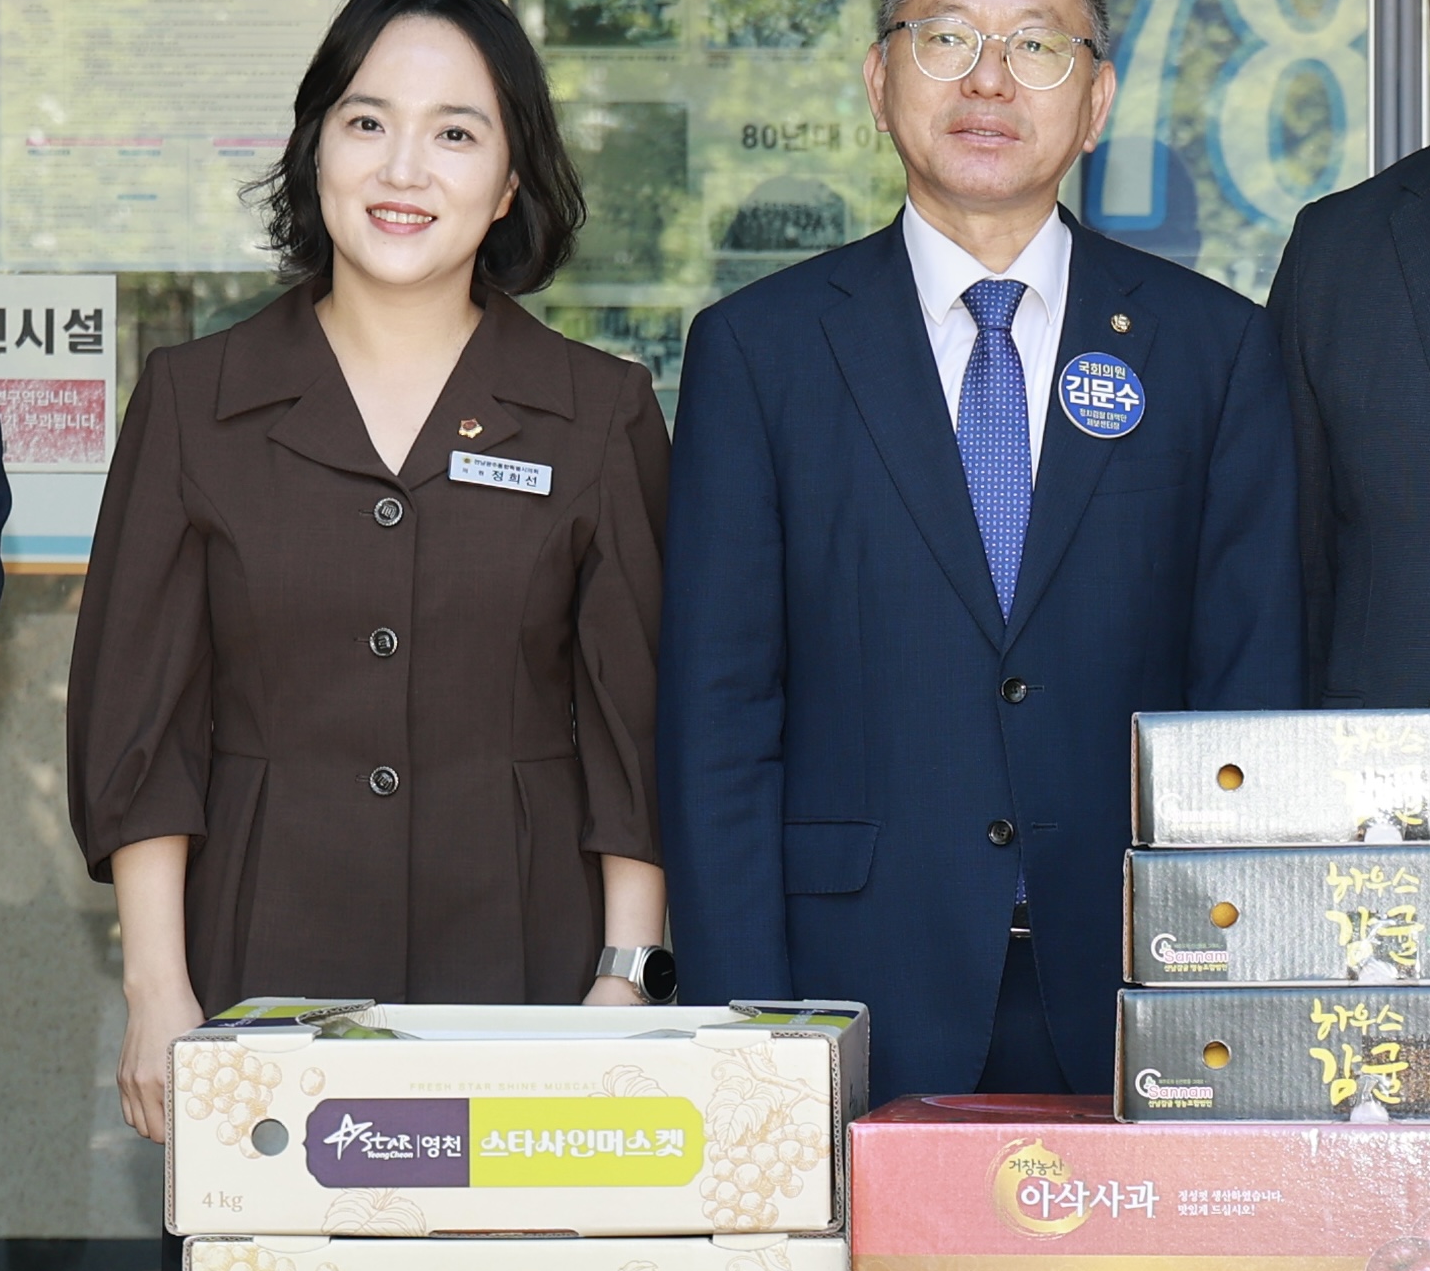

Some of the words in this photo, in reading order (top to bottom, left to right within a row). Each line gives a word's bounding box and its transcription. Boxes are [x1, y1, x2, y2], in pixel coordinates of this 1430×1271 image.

[1078, 361, 1126, 380] 국회의원
[1066, 376, 1140, 412] 김문수
[492, 469, 538, 488] 정희선
[1326, 861, 1420, 904] 하우스
[1324, 904, 1425, 968] 감귤
[1164, 949, 1229, 964] Sannam
[1310, 998, 1405, 1041] 하우스
[410, 1082, 453, 1091] FRESH
[458, 1082, 492, 1091] STAR
[498, 1081, 540, 1091] SHINE
[545, 1081, 599, 1091] MUSCAT
[1309, 1043, 1409, 1106] 감귤
[1147, 1085, 1214, 1100] Sannam
[421, 1135, 462, 1159] 영천
[478, 1129, 685, 1159] 스타샤인머스켓
[1009, 1159, 1065, 1177] 거창농산
[201, 1191, 213, 1209] 4
[217, 1190, 244, 1213] kg
[1021, 1180, 1160, 1219] 아삭사과
[1211, 1189, 1286, 1204] 생산하였습니다.
[1177, 1204, 1210, 1216] 맛있게
[1211, 1204, 1256, 1217] 드십시오!
